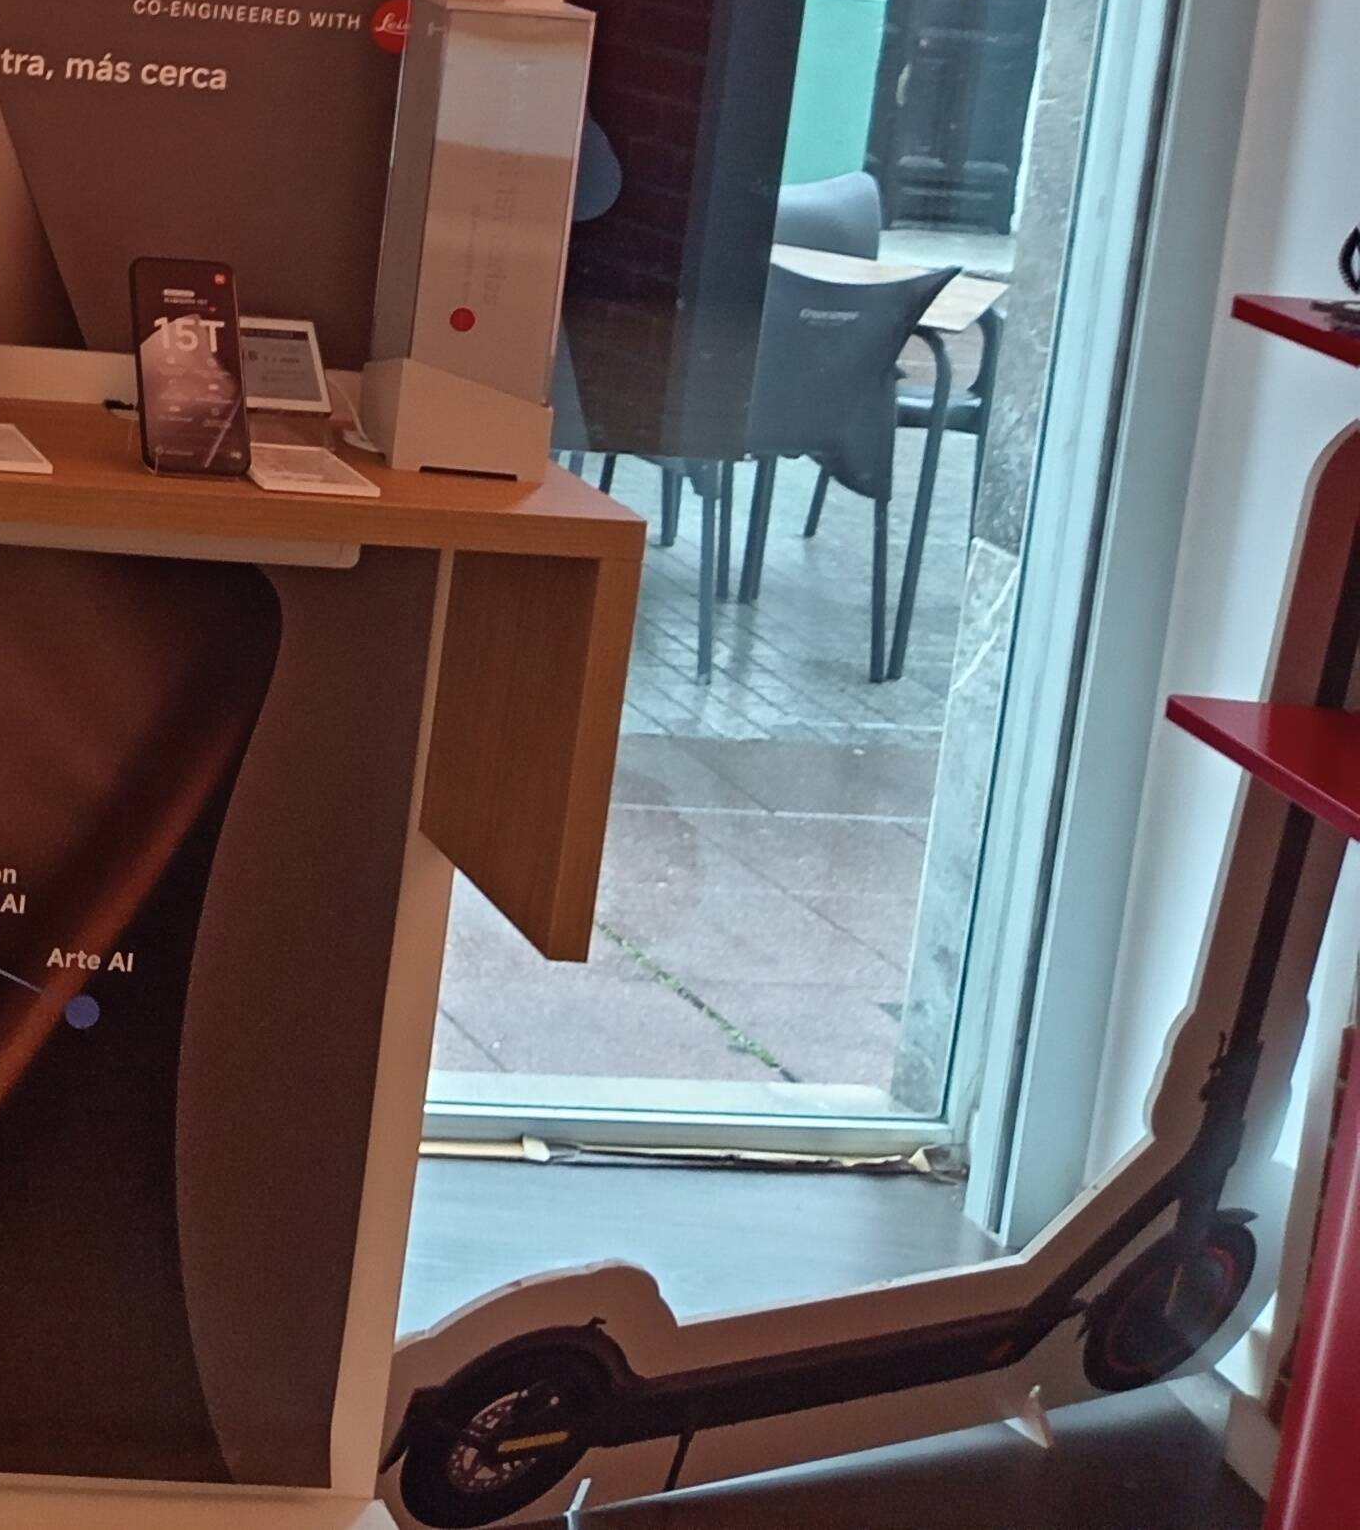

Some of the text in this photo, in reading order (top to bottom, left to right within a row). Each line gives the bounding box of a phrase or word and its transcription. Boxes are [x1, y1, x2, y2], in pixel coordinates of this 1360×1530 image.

[309, 10, 362, 32] WITH
[65, 52, 131, 84] más
[140, 62, 228, 91] cerca
[152, 315, 225, 355] 15T
[0, 891, 27, 915] AI
[46, 947, 135, 974] Arte AI
